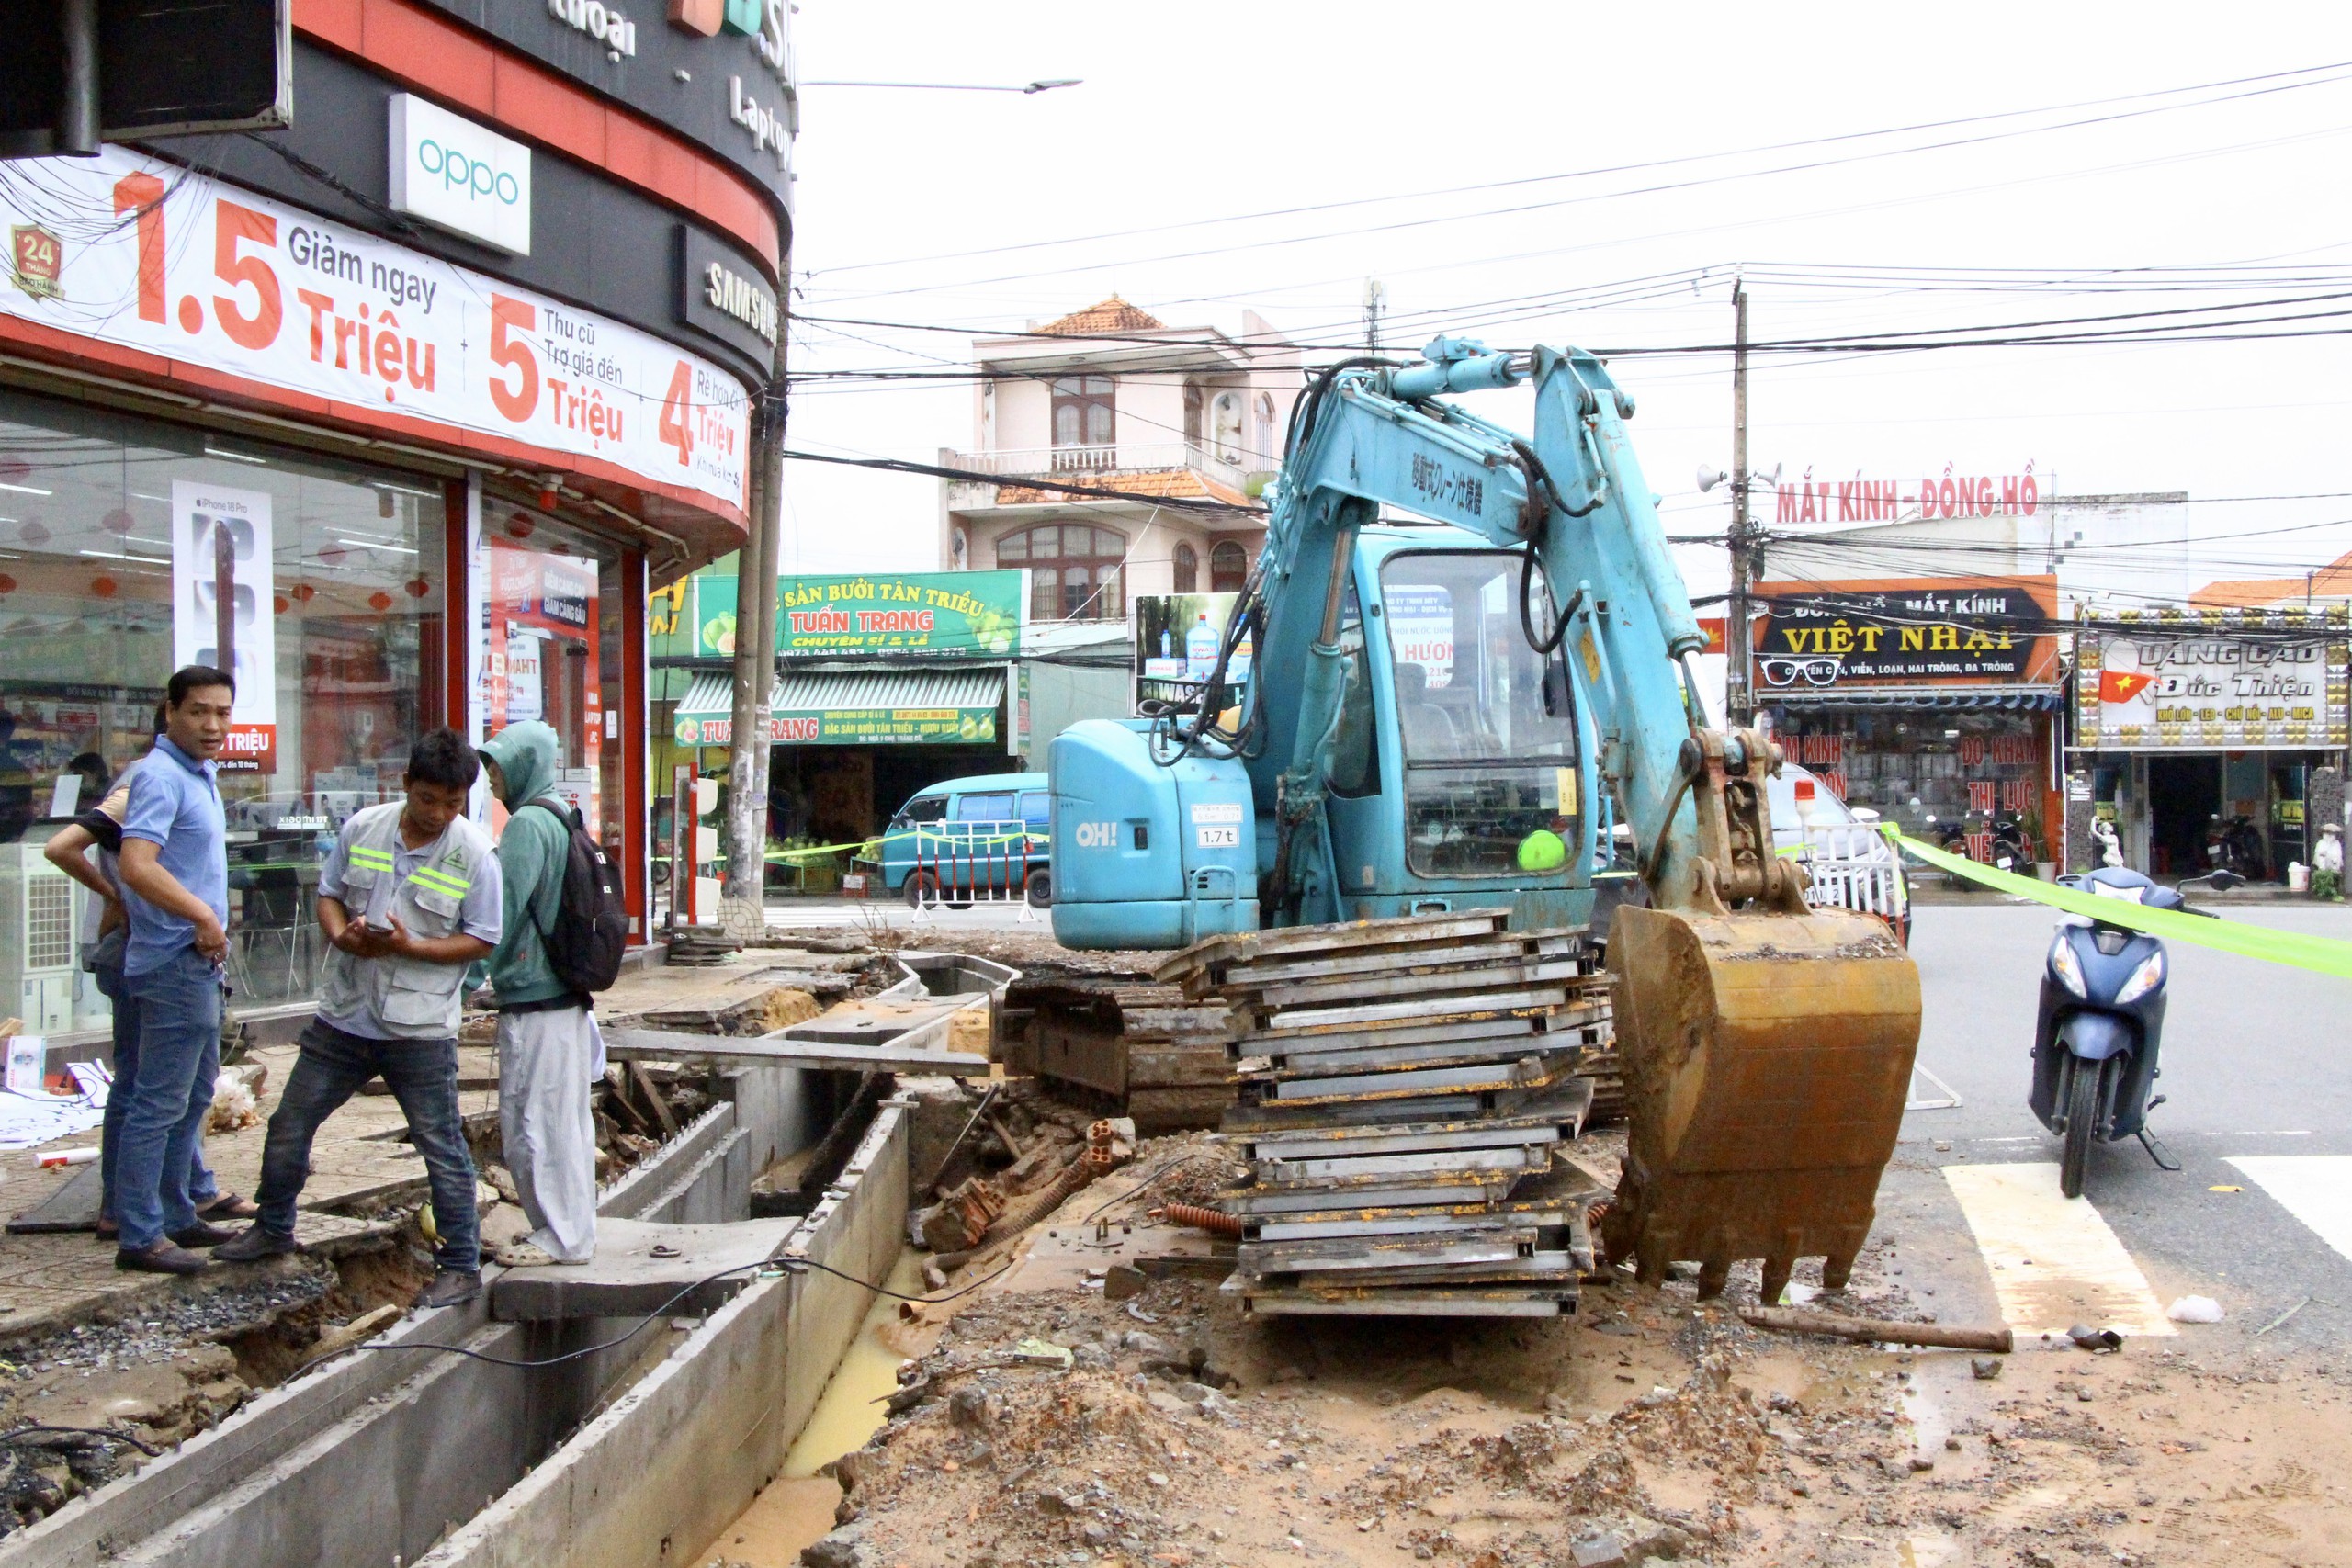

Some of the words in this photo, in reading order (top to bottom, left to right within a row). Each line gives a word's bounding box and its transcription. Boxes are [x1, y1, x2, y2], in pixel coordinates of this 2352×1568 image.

[419, 140, 518, 205] oppo
[24, 234, 53, 265] 24
[114, 171, 283, 350] 1.5
[289, 226, 363, 285] Giảm
[372, 261, 437, 315] ngay
[544, 309, 574, 339] Thu
[578, 324, 594, 345] cũ
[297, 288, 435, 403] Triệu
[489, 293, 539, 423] 5
[544, 339, 569, 374] Trợ
[573, 349, 594, 378] giá
[598, 354, 623, 385] đến
[547, 378, 623, 450] Triệu
[659, 359, 694, 467] 4
[697, 404, 735, 462] Triệu
[236, 502, 248, 514] Pro
[1776, 465, 1831, 524] MẮT
[1839, 469, 1898, 523] KÍNH
[1921, 461, 1995, 519] ĐỒNG
[2001, 458, 2038, 517] HỒ
[785, 582, 823, 609] SẢN
[829, 577, 875, 601] BƯỞI
[879, 580, 922, 603] TÂN
[925, 589, 985, 618] TRIỀU
[1955, 593, 2007, 614] KÍNH
[788, 603, 851, 635] TUẤN
[855, 608, 935, 634] TRANG
[792, 636, 864, 647] CHUYÊN
[888, 636, 903, 647] &
[1782, 618, 1884, 660] VIỆT
[1851, 660, 1876, 676] VIỄN,
[1878, 665, 1906, 677] LOẠN,
[1908, 664, 1925, 674] HAI
[1927, 660, 1962, 675] TRÒNG,
[1982, 660, 2015, 672] TRÒNG
[2154, 674, 2222, 698] Đức
[2233, 672, 2315, 702] Thiện
[770, 718, 819, 741] RANG
[2156, 704, 2175, 722] KHỔ
[2199, 708, 2216, 722] LED
[2225, 705, 2245, 722] CHỮ
[2267, 706, 2284, 721] ALU
[2291, 706, 2314, 721] MICA
[226, 728, 269, 757] TRIỆU
[1804, 728, 1843, 764] KÍNH
[1961, 736, 1984, 766] ĐO
[1967, 781, 1996, 818] THỊ
[1076, 822, 1117, 847] OH!
